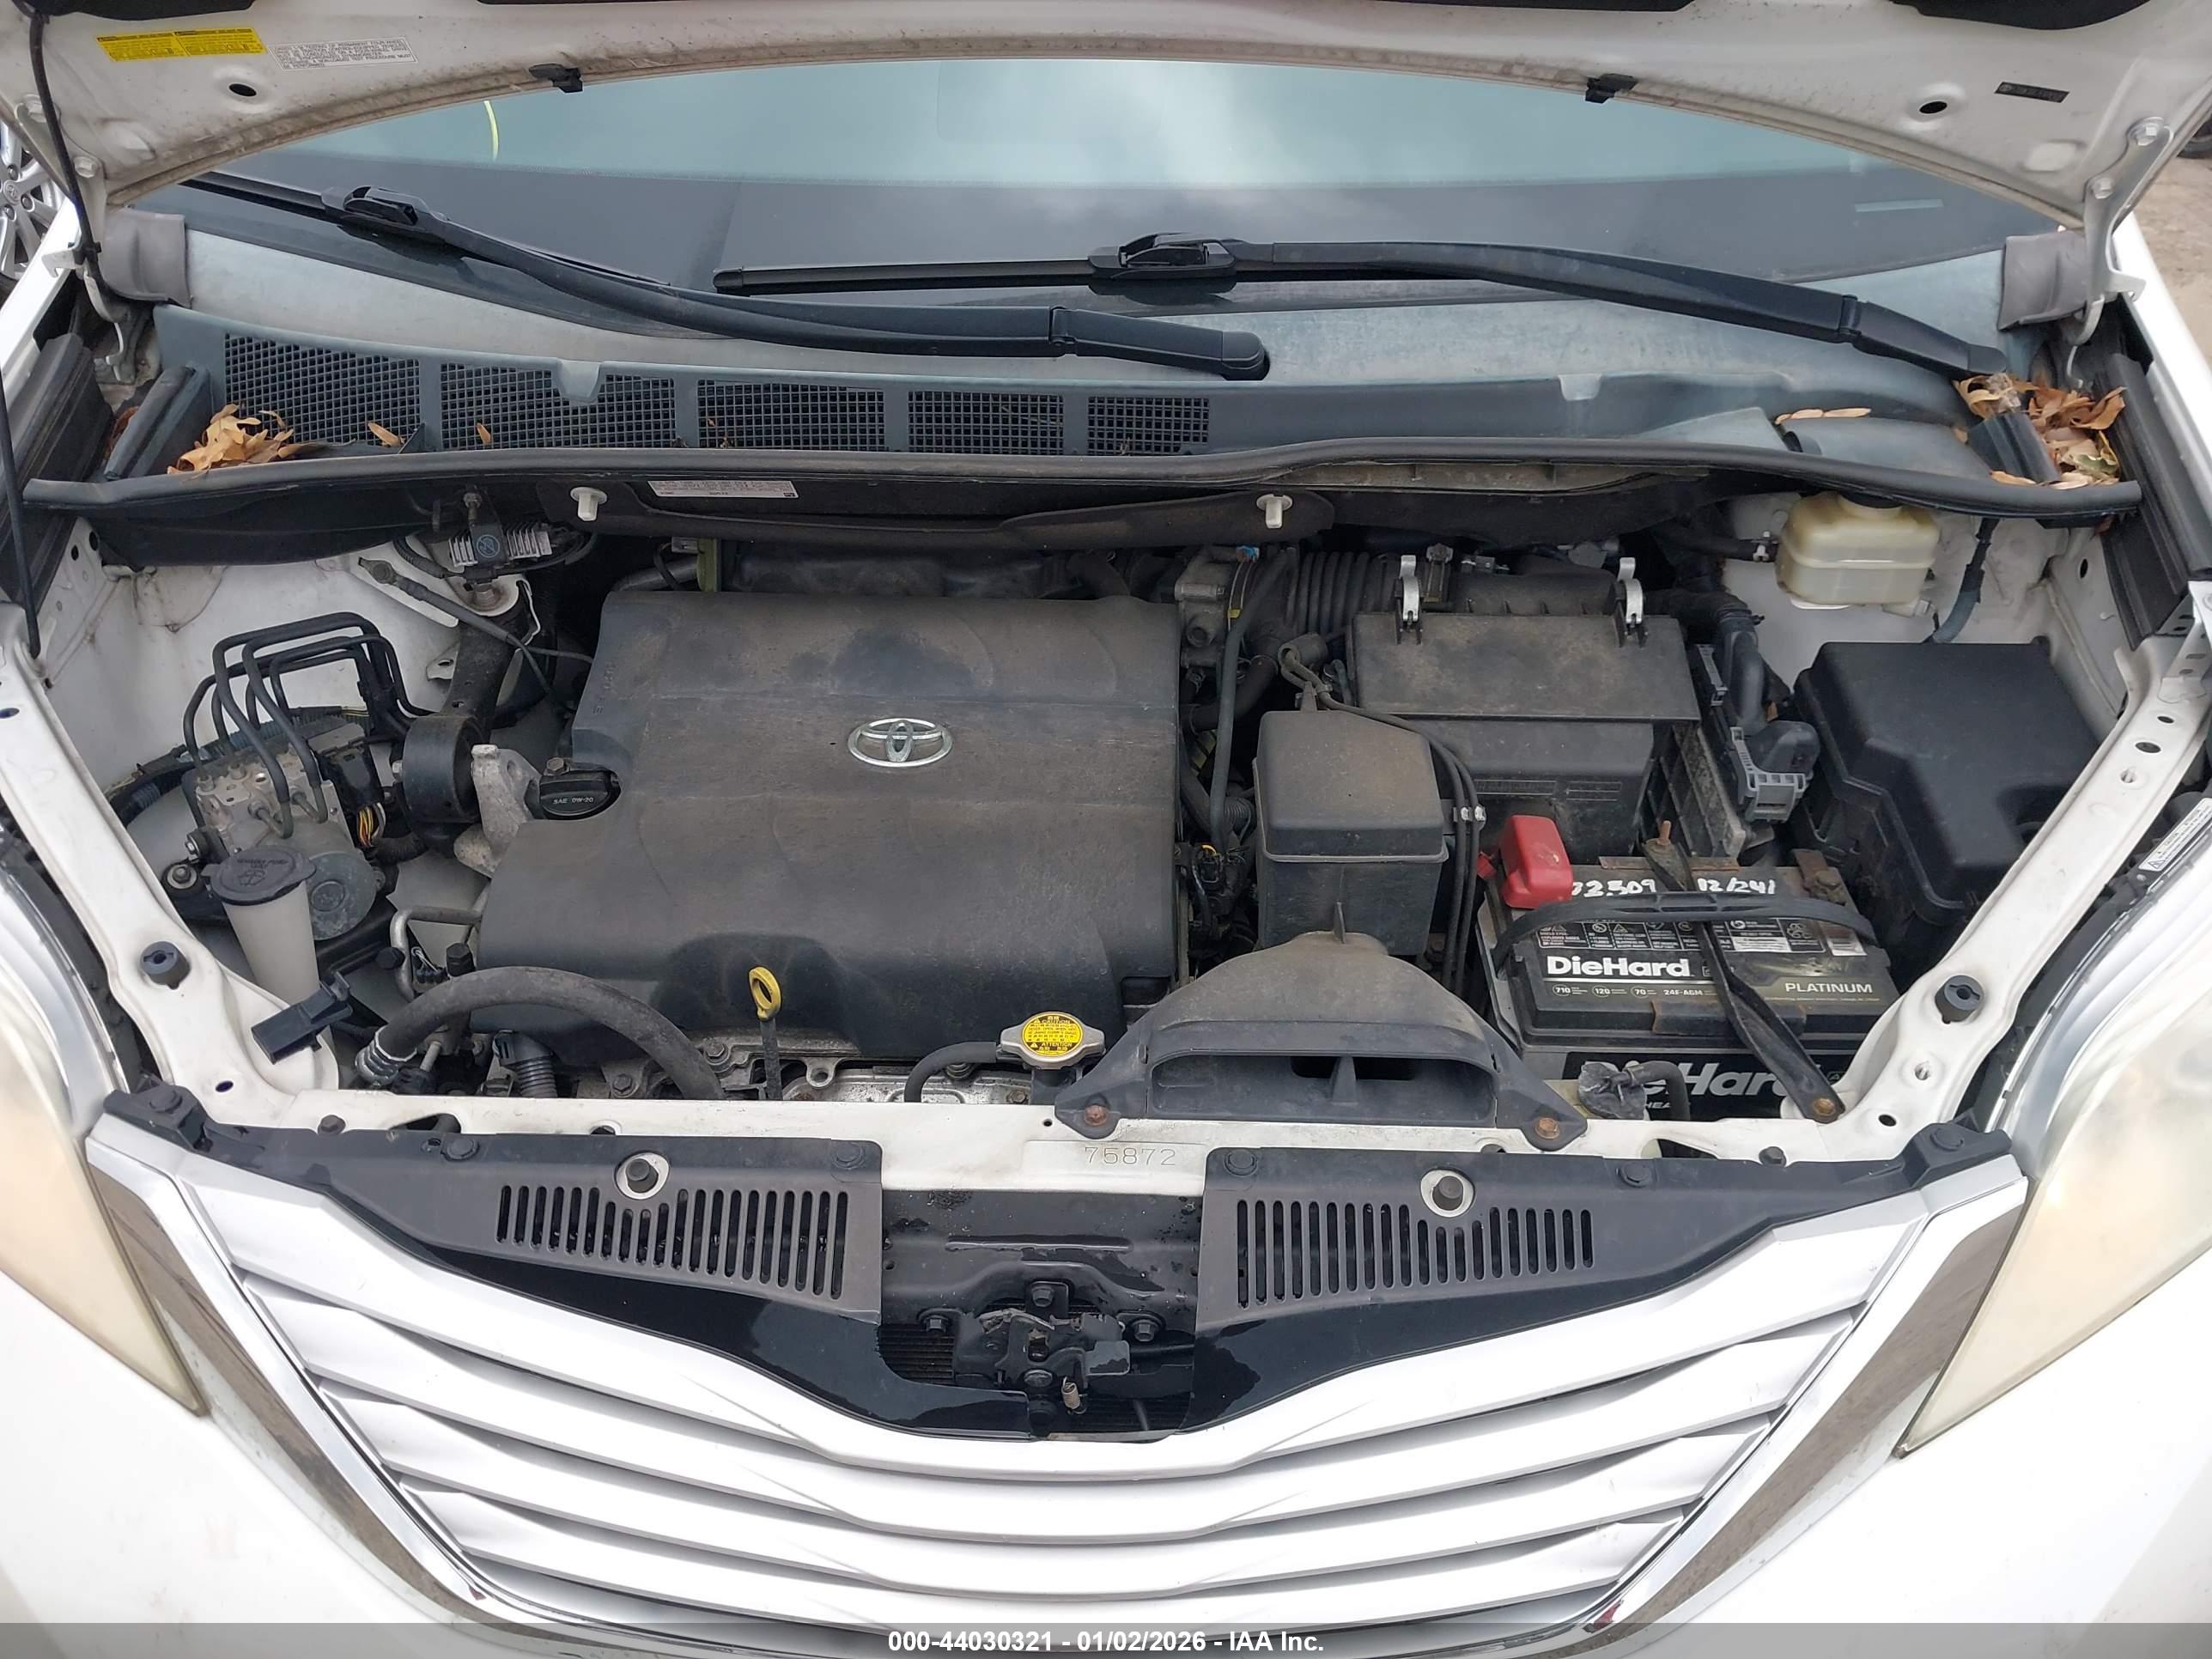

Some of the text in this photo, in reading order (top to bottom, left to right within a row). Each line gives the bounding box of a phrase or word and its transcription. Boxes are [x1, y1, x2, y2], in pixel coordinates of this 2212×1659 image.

[1547, 955, 1691, 977] DieHard
[1785, 982, 1873, 994] PLATINUM
[1085, 1146, 1176, 1166] 75872
